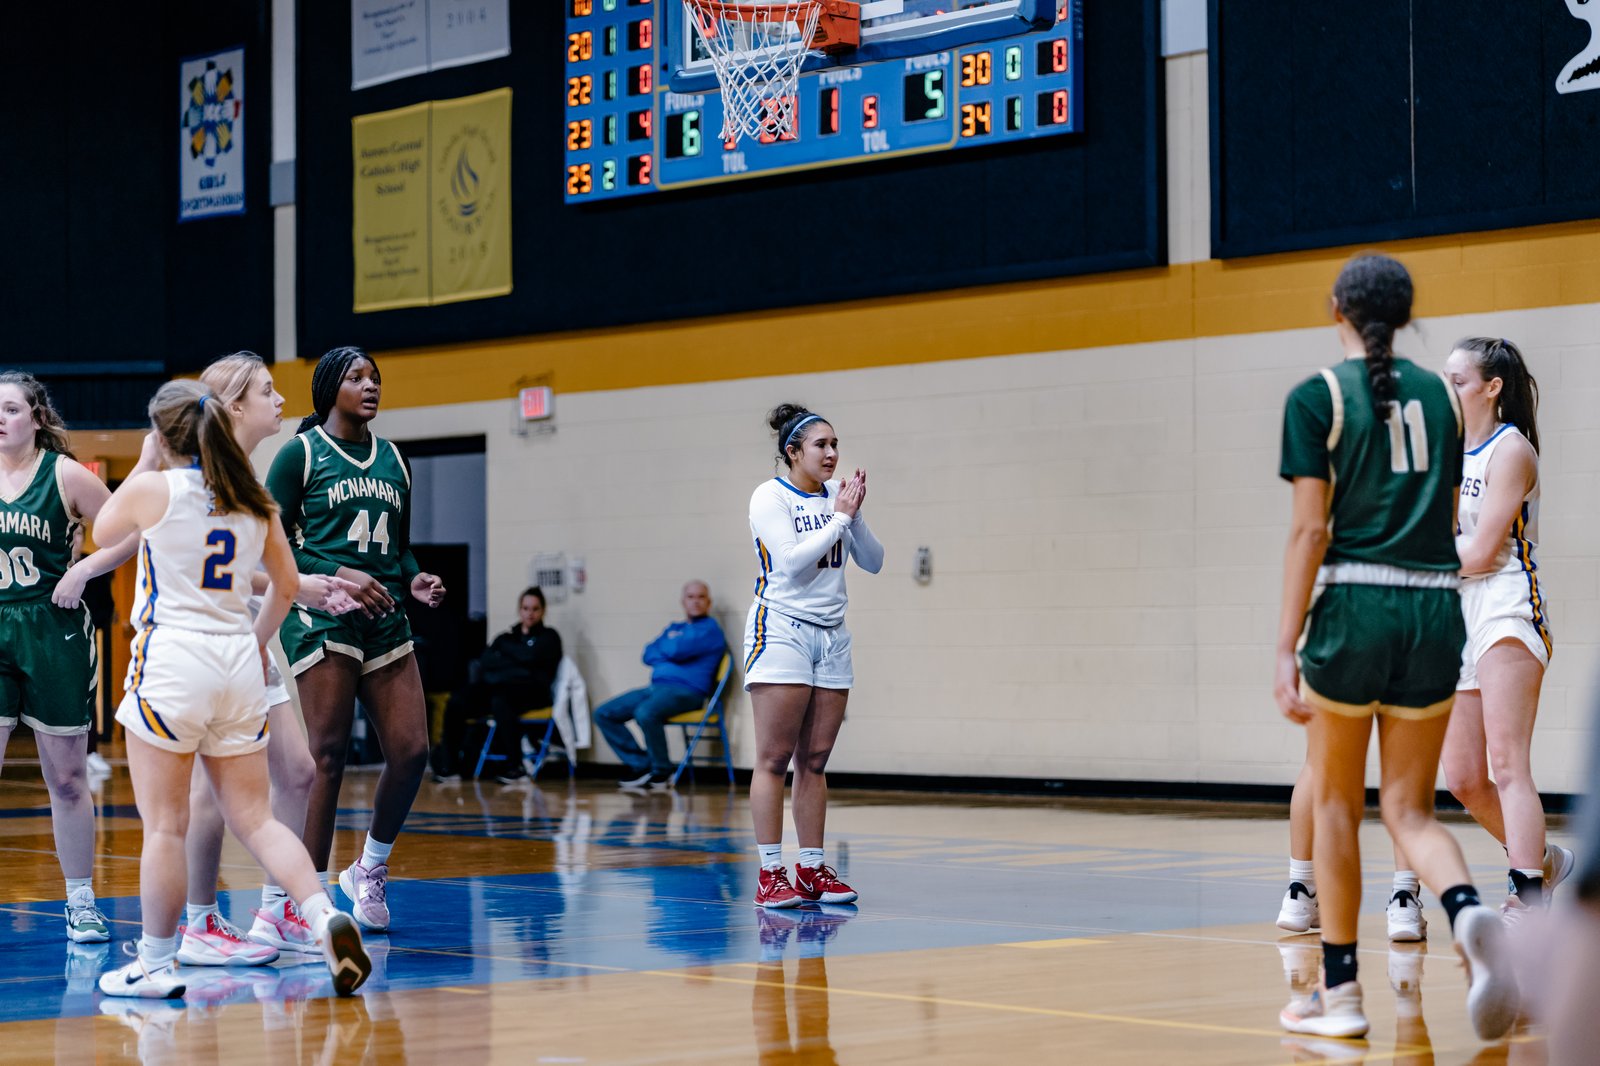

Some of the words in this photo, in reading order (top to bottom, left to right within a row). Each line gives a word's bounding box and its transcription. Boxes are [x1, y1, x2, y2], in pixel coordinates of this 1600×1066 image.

[567, 31, 592, 63] 20
[639, 19, 652, 49] 0
[961, 52, 991, 87] 30
[1005, 46, 1021, 81] 0
[1052, 39, 1068, 73] 0
[567, 75, 592, 107] 22
[639, 64, 652, 94] 0
[924, 69, 945, 119] 5
[567, 119, 592, 151] 23
[639, 110, 652, 138] 4
[682, 111, 700, 156] 6
[863, 96, 877, 129] 5
[961, 102, 991, 138] 34
[1052, 89, 1068, 124] 0
[567, 163, 592, 195] 25
[602, 160, 616, 191] 2
[639, 154, 652, 185] 2
[1384, 399, 1429, 473] 11
[327, 477, 402, 513] MCNAMARA
[347, 509, 390, 555] 44
[200, 528, 237, 592] 2
